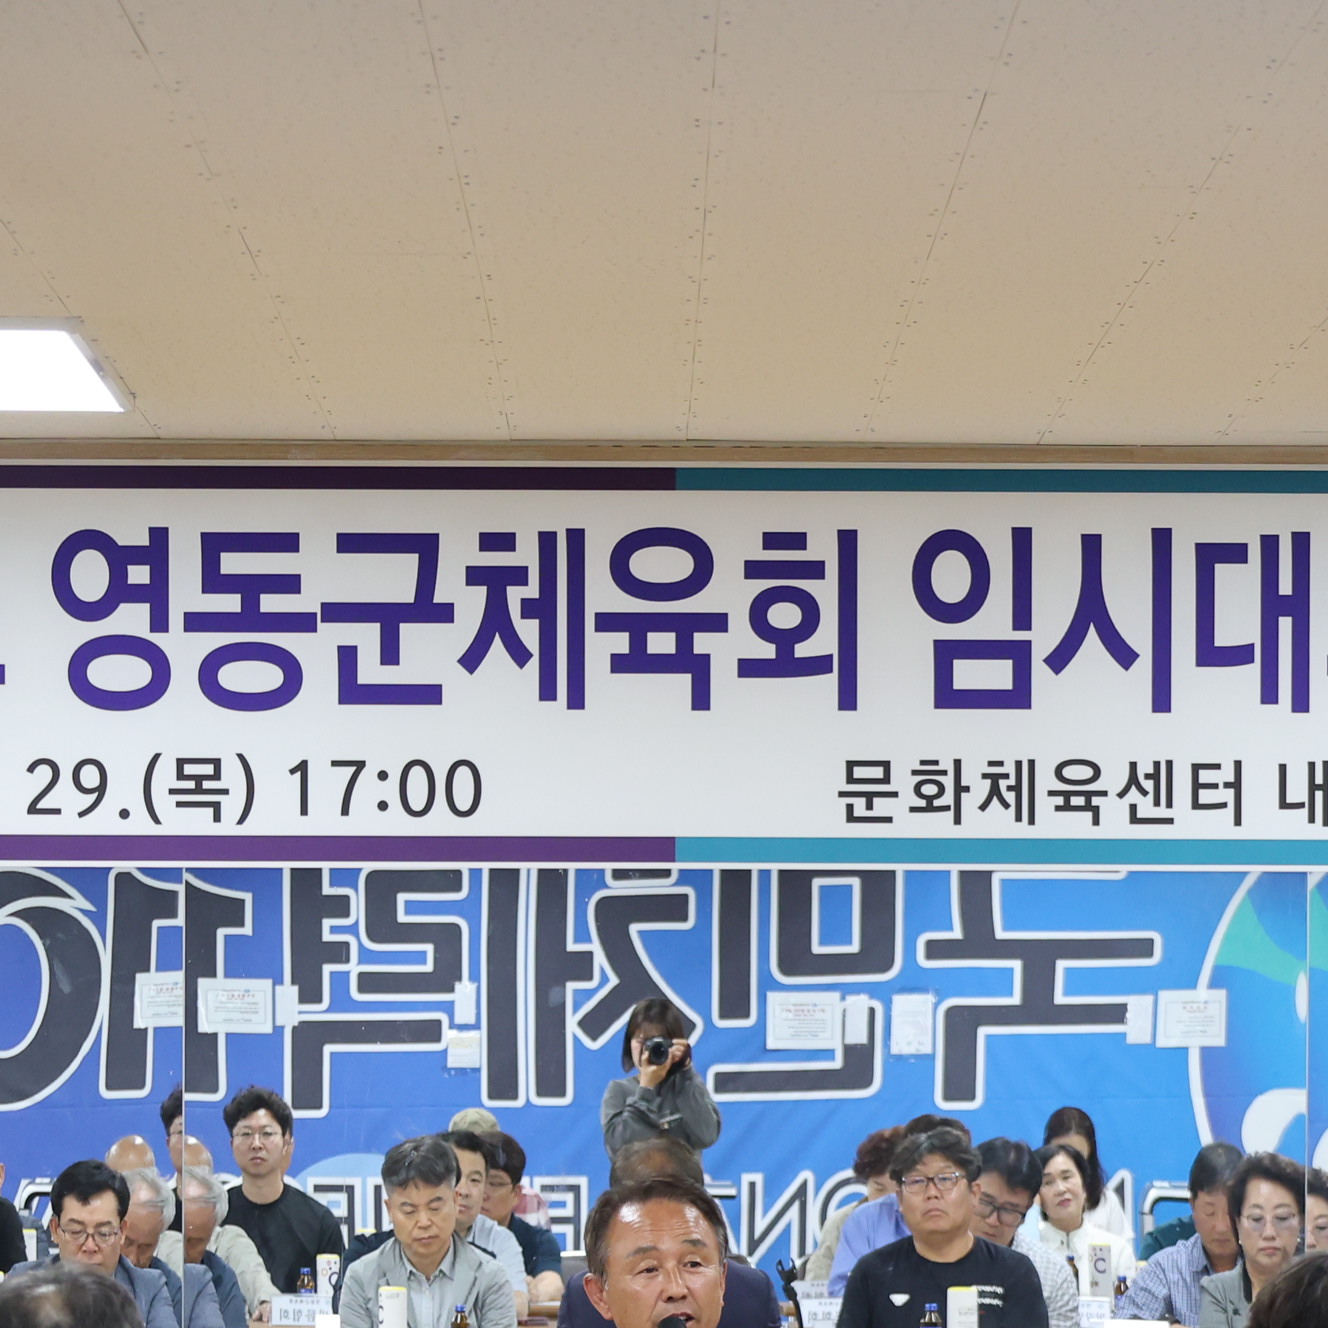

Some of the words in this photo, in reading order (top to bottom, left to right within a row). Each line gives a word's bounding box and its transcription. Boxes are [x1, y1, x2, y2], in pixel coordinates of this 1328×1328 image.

[50, 525, 859, 712] 영동군체육회
[25, 752, 256, 826] 29.(목)
[288, 757, 484, 818] 17:00
[838, 756, 1244, 828] 문화체육센터
